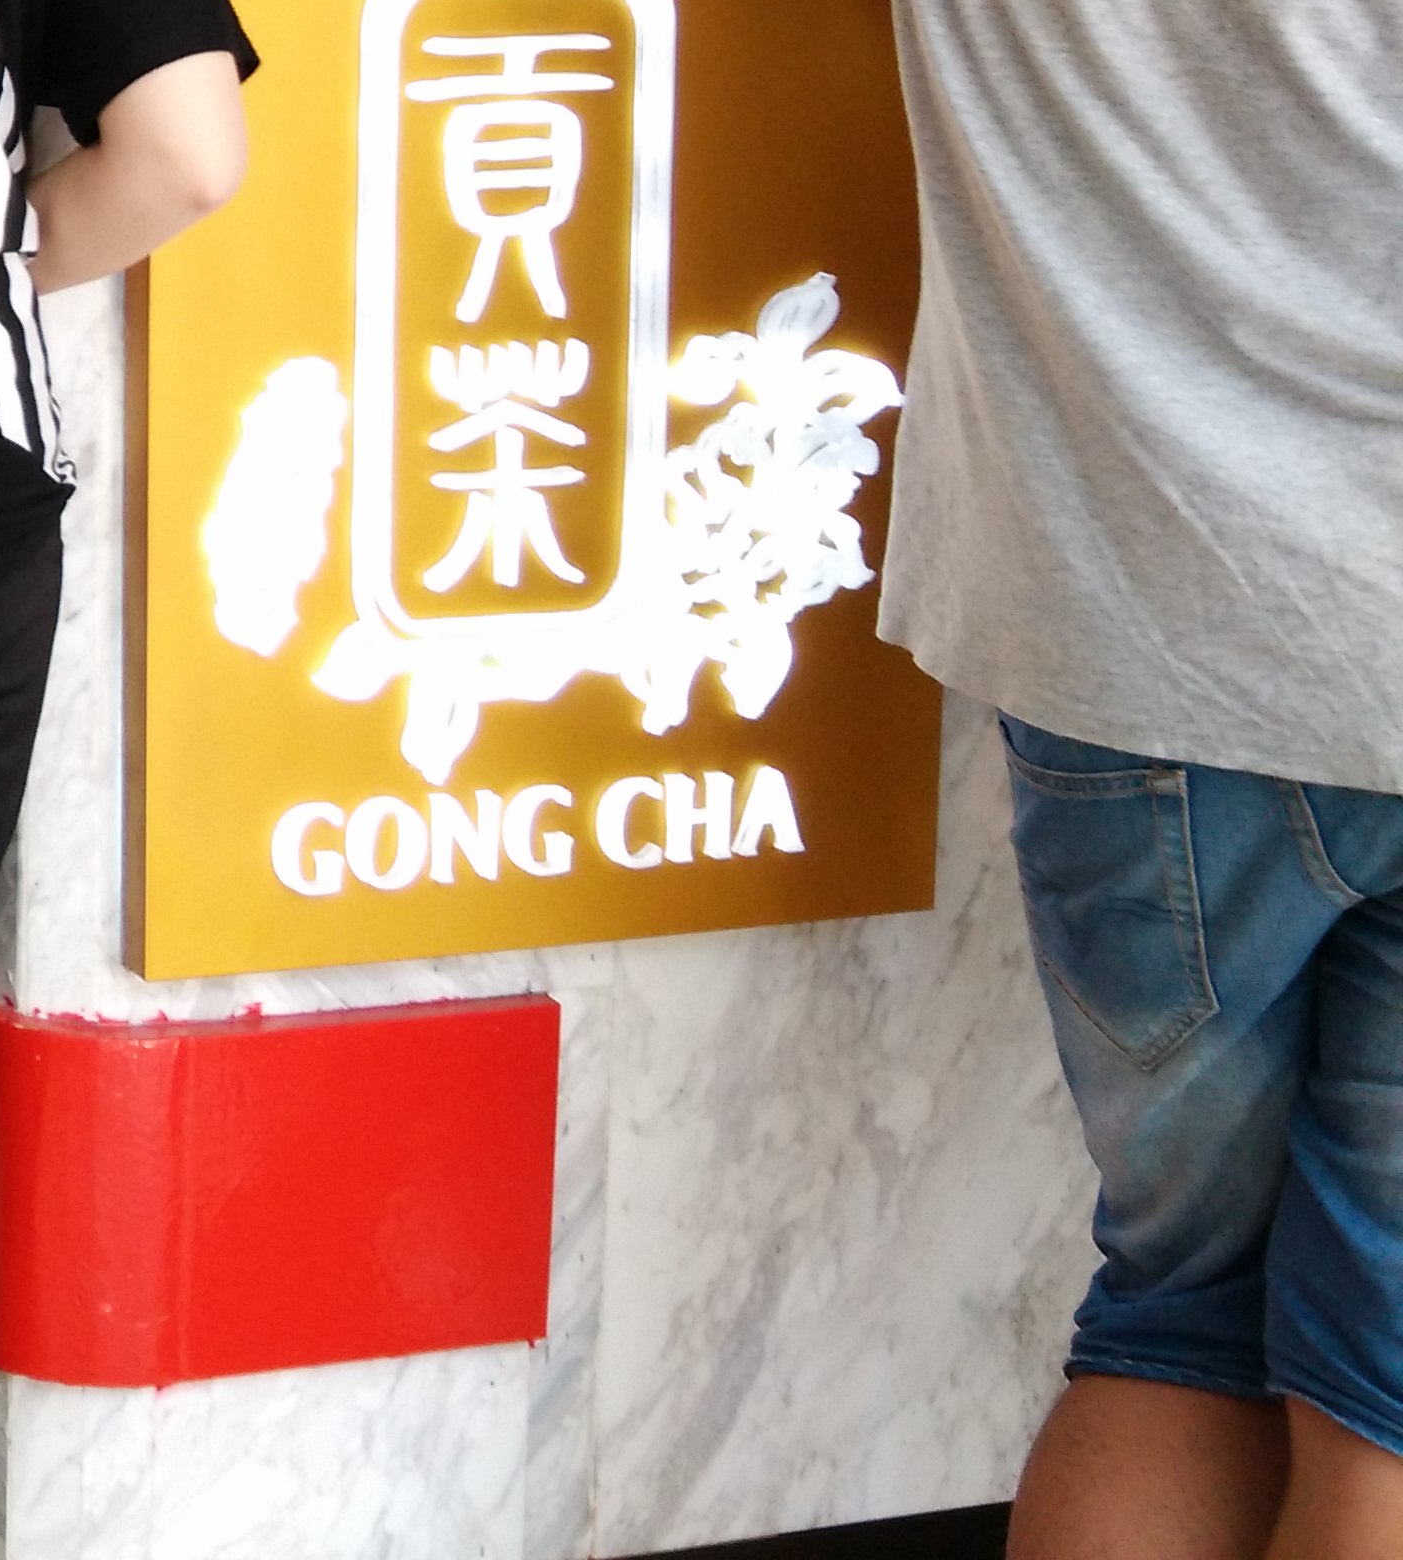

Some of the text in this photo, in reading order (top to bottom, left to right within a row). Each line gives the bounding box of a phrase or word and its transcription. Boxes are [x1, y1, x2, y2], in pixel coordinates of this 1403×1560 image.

[404, 33, 615, 593] 貢茶
[270, 764, 806, 897] GONG CHA
